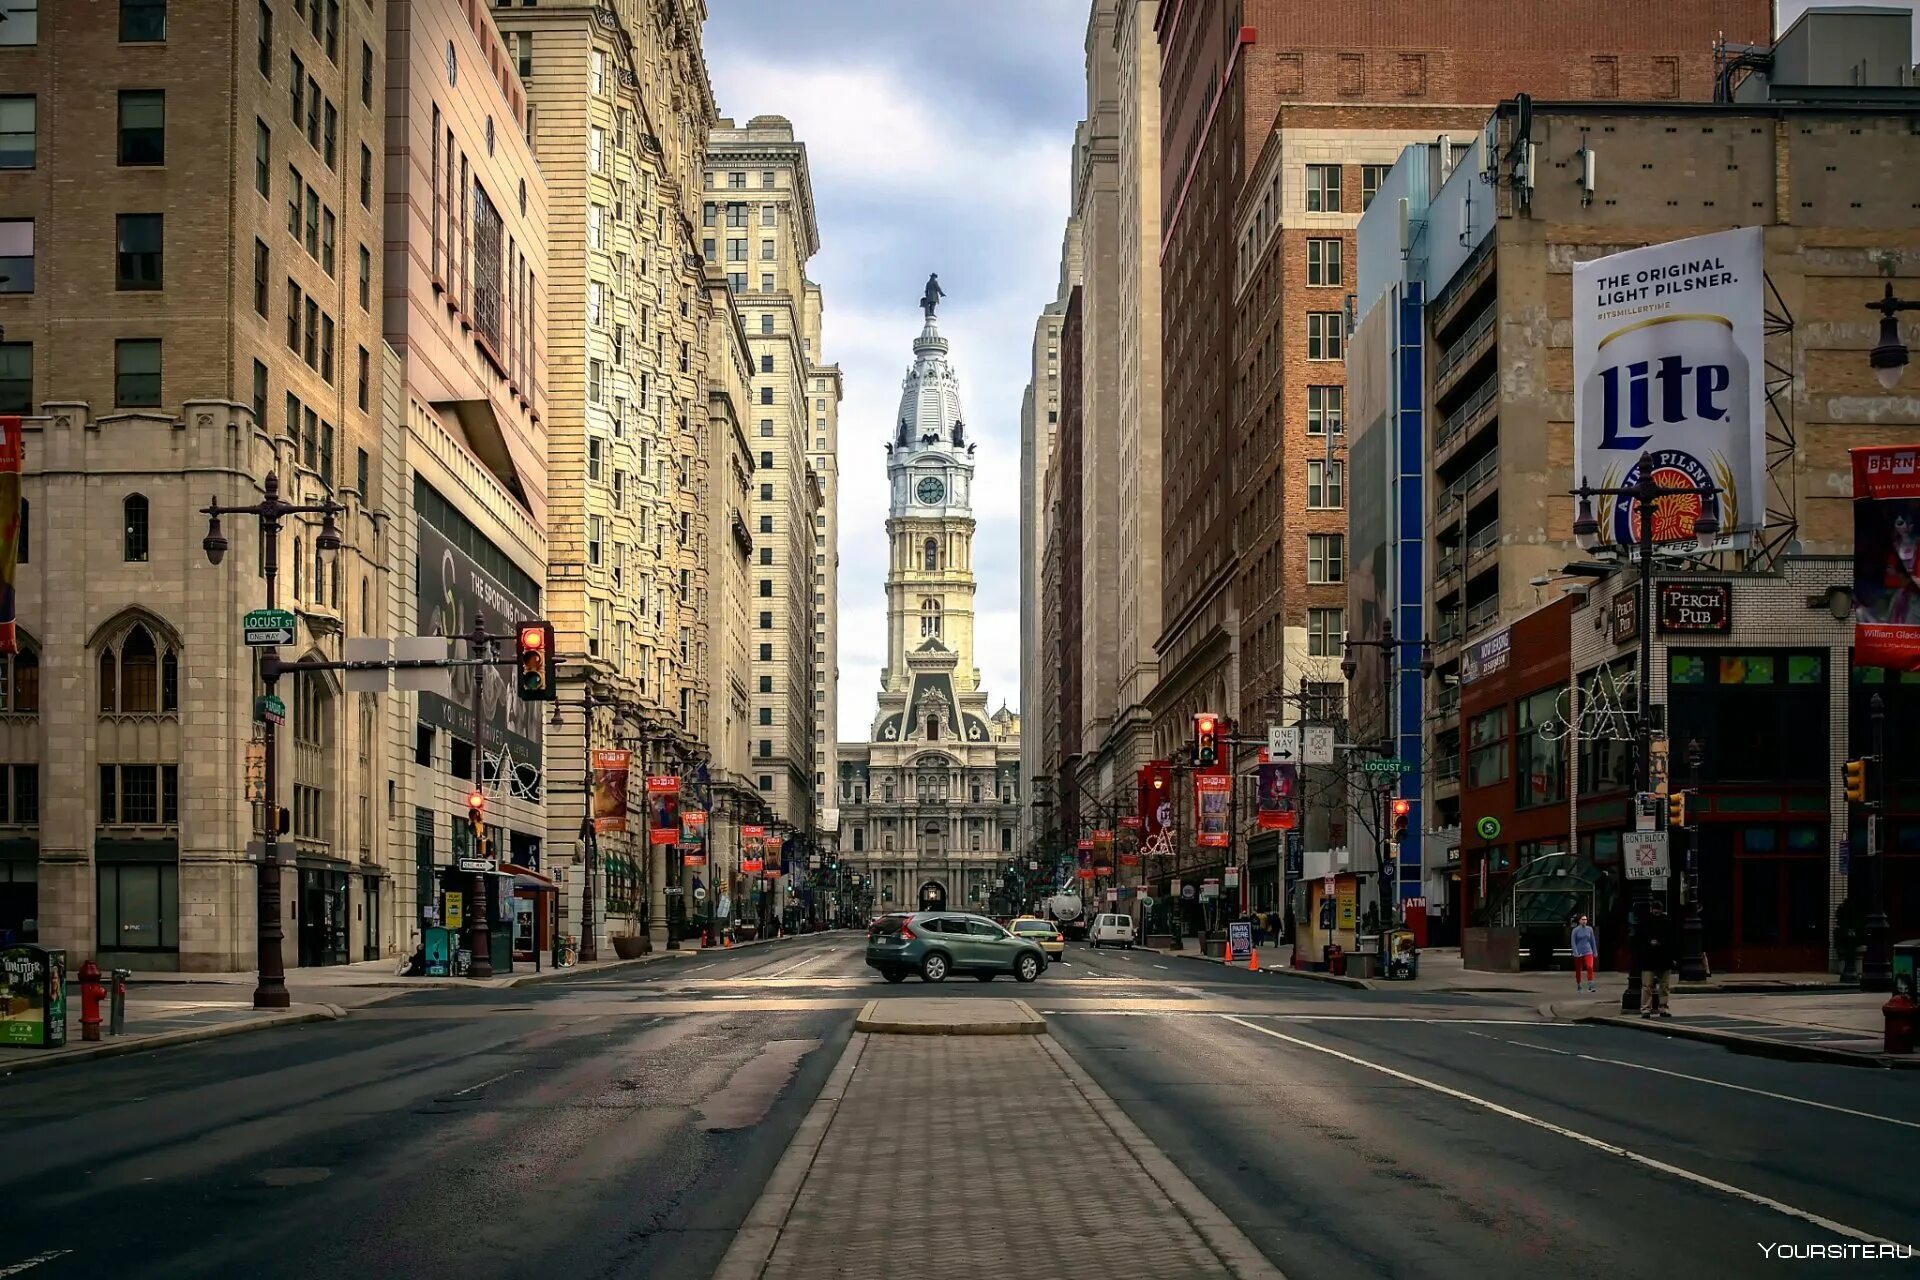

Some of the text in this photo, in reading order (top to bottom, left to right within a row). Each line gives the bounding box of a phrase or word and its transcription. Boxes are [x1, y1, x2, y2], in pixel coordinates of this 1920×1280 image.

[1597, 257, 1725, 290] THE ORIGINAL
[1597, 272, 1738, 307] LIGHT PILSNER.
[1597, 302, 1671, 320] #ITSMILLERTIME
[1597, 355, 1730, 450] Lite
[470, 571, 484, 600] THE
[484, 583, 514, 623] SPORTING
[1669, 592, 1720, 608] PERCH
[1616, 600, 1633, 618] PERCH
[1679, 608, 1711, 623] PUB
[245, 616, 293, 628] LOCUST ST
[1619, 618, 1631, 632] PUB
[1864, 629, 1894, 639] William
[1274, 730, 1293, 738] ONE
[1365, 763, 1400, 771] LOCUST
[1406, 898, 1426, 907] ATM
